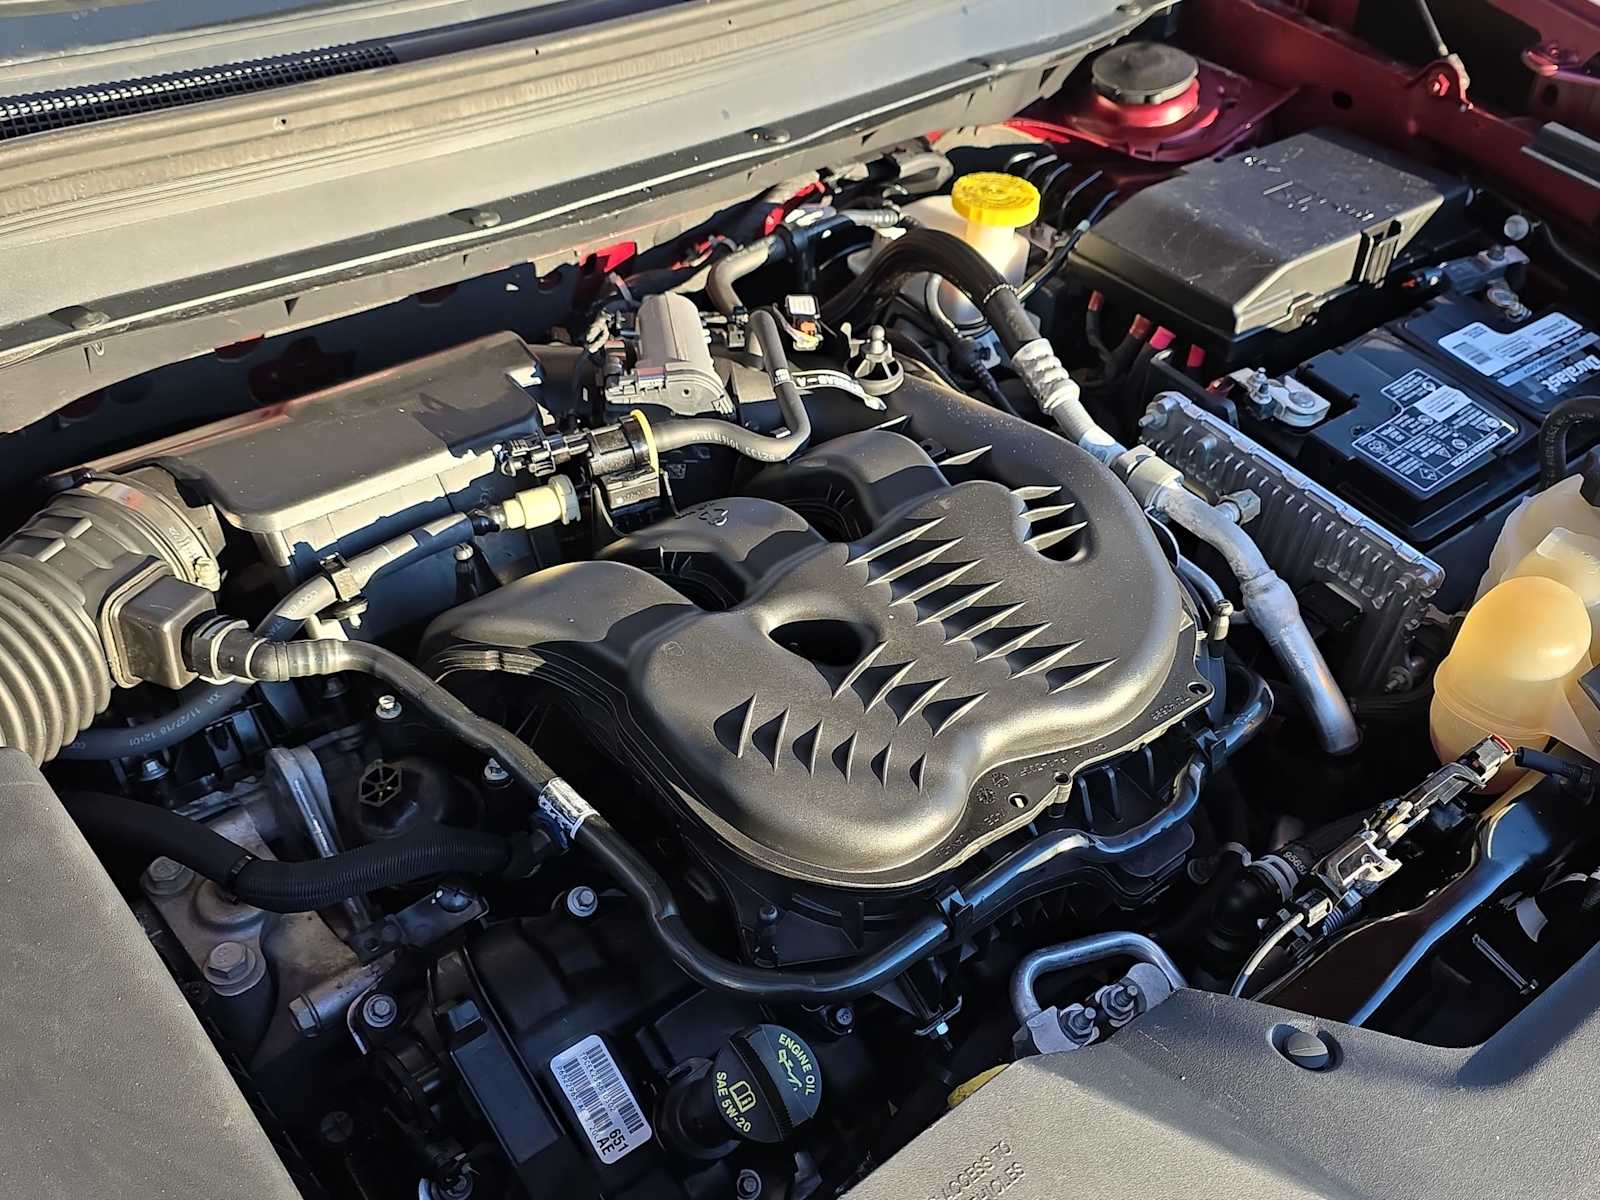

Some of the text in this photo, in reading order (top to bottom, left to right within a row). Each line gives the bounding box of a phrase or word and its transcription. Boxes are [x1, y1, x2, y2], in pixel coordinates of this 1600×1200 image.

[1540, 354, 1600, 393] Duralast
[779, 1033, 815, 1095] ENGINE OIL
[716, 1072, 751, 1132] SAE 5W-20
[597, 1138, 615, 1155] AE
[609, 1128, 629, 1152] 651
[990, 1141, 1012, 1160] TO
